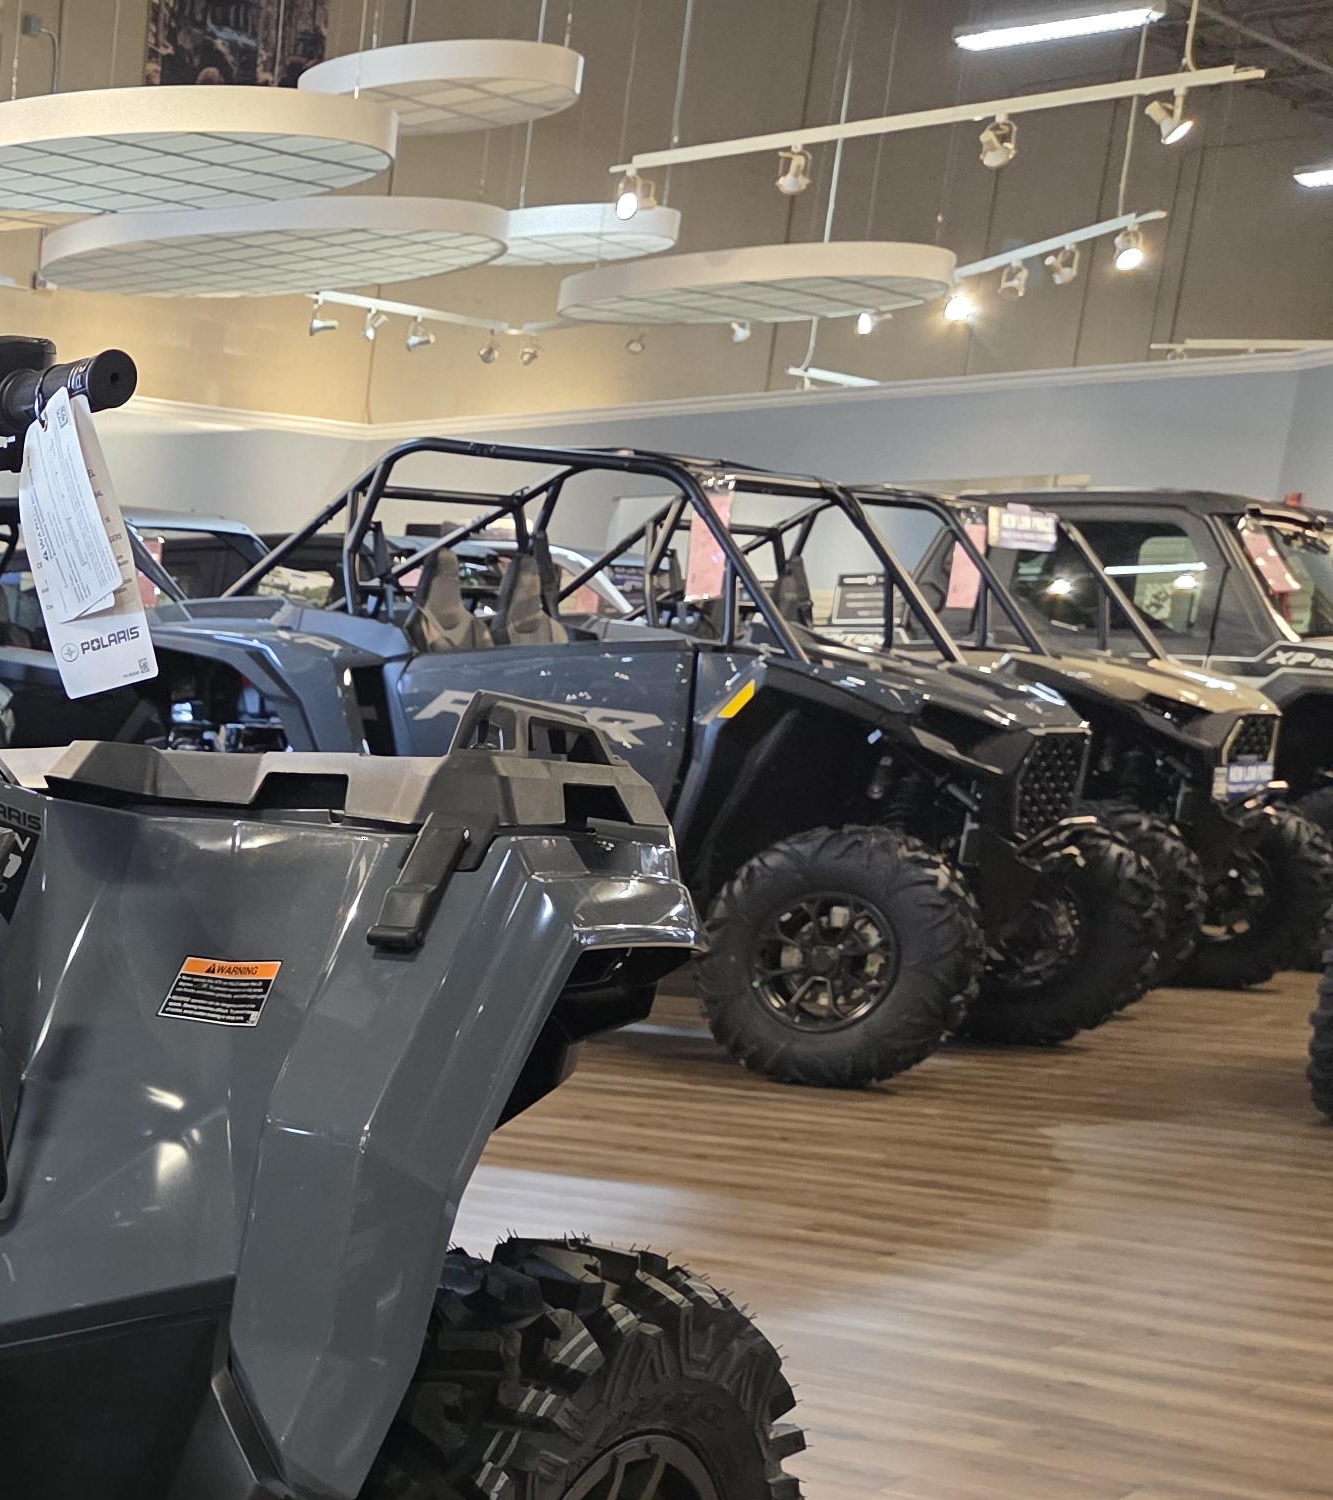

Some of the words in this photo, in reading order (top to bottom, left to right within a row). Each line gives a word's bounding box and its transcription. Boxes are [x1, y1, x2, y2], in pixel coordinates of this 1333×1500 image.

[80, 626, 140, 654] POLARIS
[1266, 650, 1316, 665] XP
[216, 965, 259, 976] WARNING
